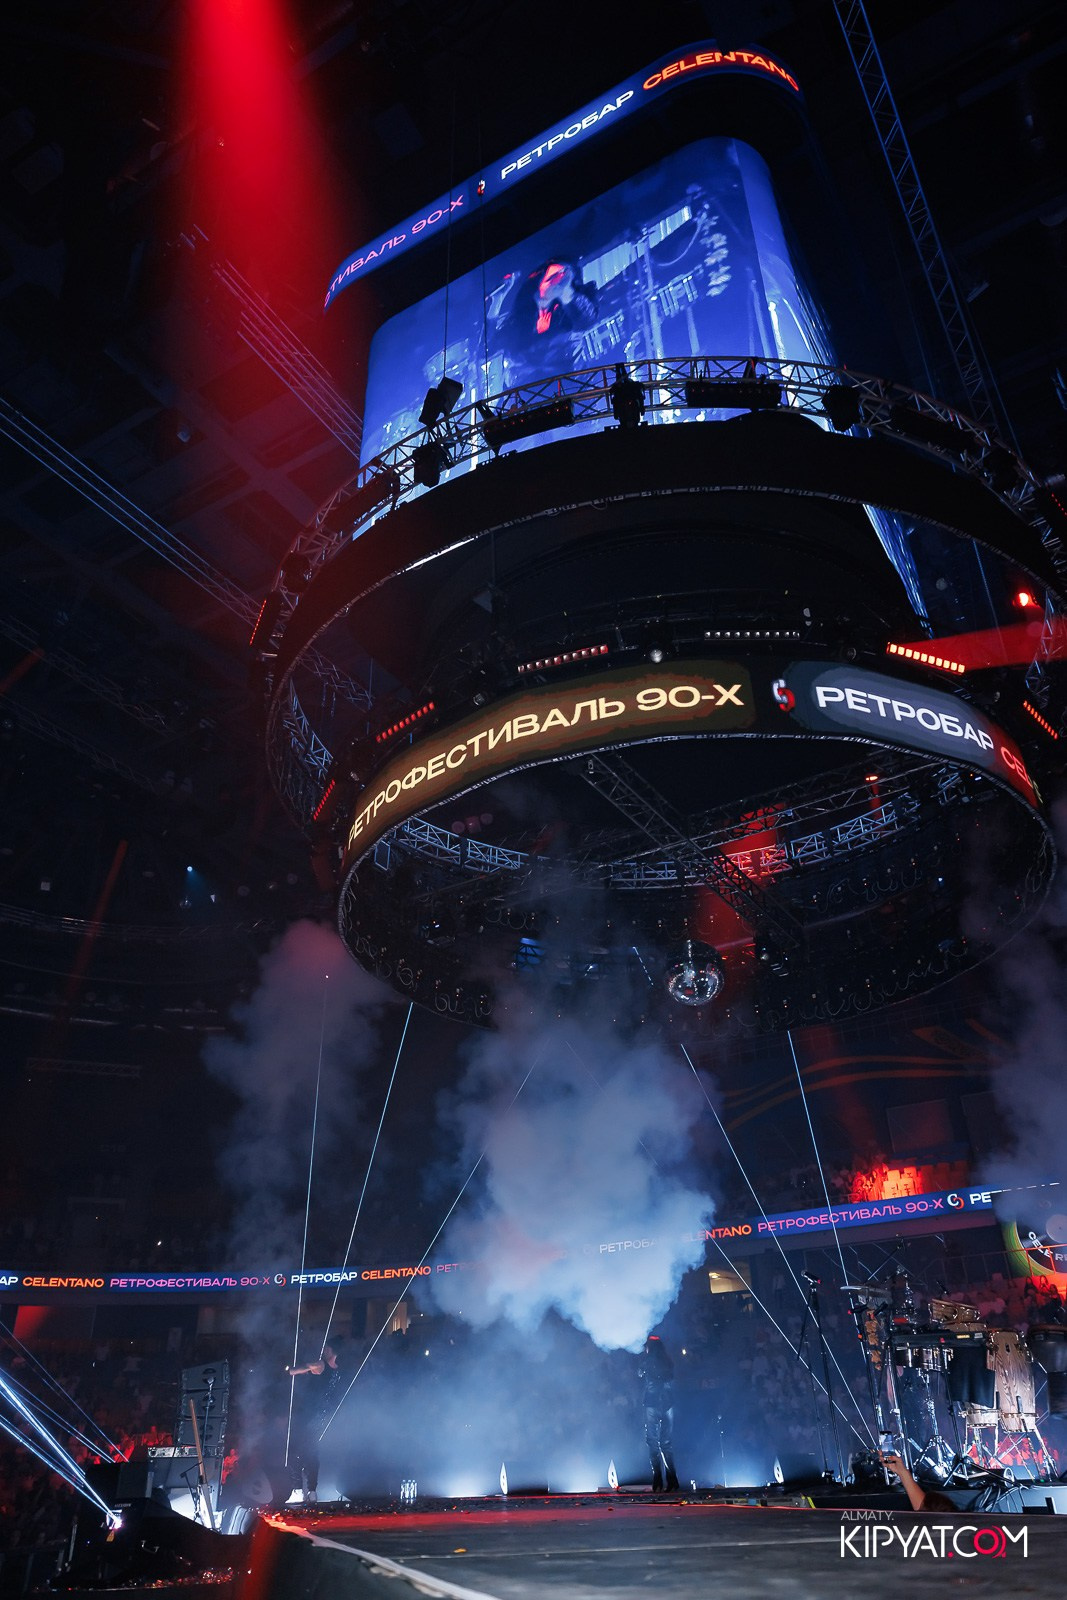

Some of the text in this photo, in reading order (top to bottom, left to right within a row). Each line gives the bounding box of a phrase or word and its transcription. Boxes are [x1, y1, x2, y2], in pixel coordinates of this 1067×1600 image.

[643, 51, 799, 91] CELENTANO
[501, 90, 634, 179] РЕТРОБАР
[411, 194, 464, 234] 90-Х
[815, 686, 994, 750] РЕТРОБАР
[348, 684, 745, 850] РЕТРОФЕСТИВАЛЬ 90-Х
[757, 1198, 944, 1233] РЕТРОФЕСТИВАЛЬ 90-Х
[22, 1276, 105, 1288] CELENTANO
[110, 1276, 270, 1288] РЕТРОФЕСТИВАЛЬ 90-Х
[291, 1271, 358, 1284] РЕТРОБАР
[361, 1265, 432, 1281] CELENTANO
